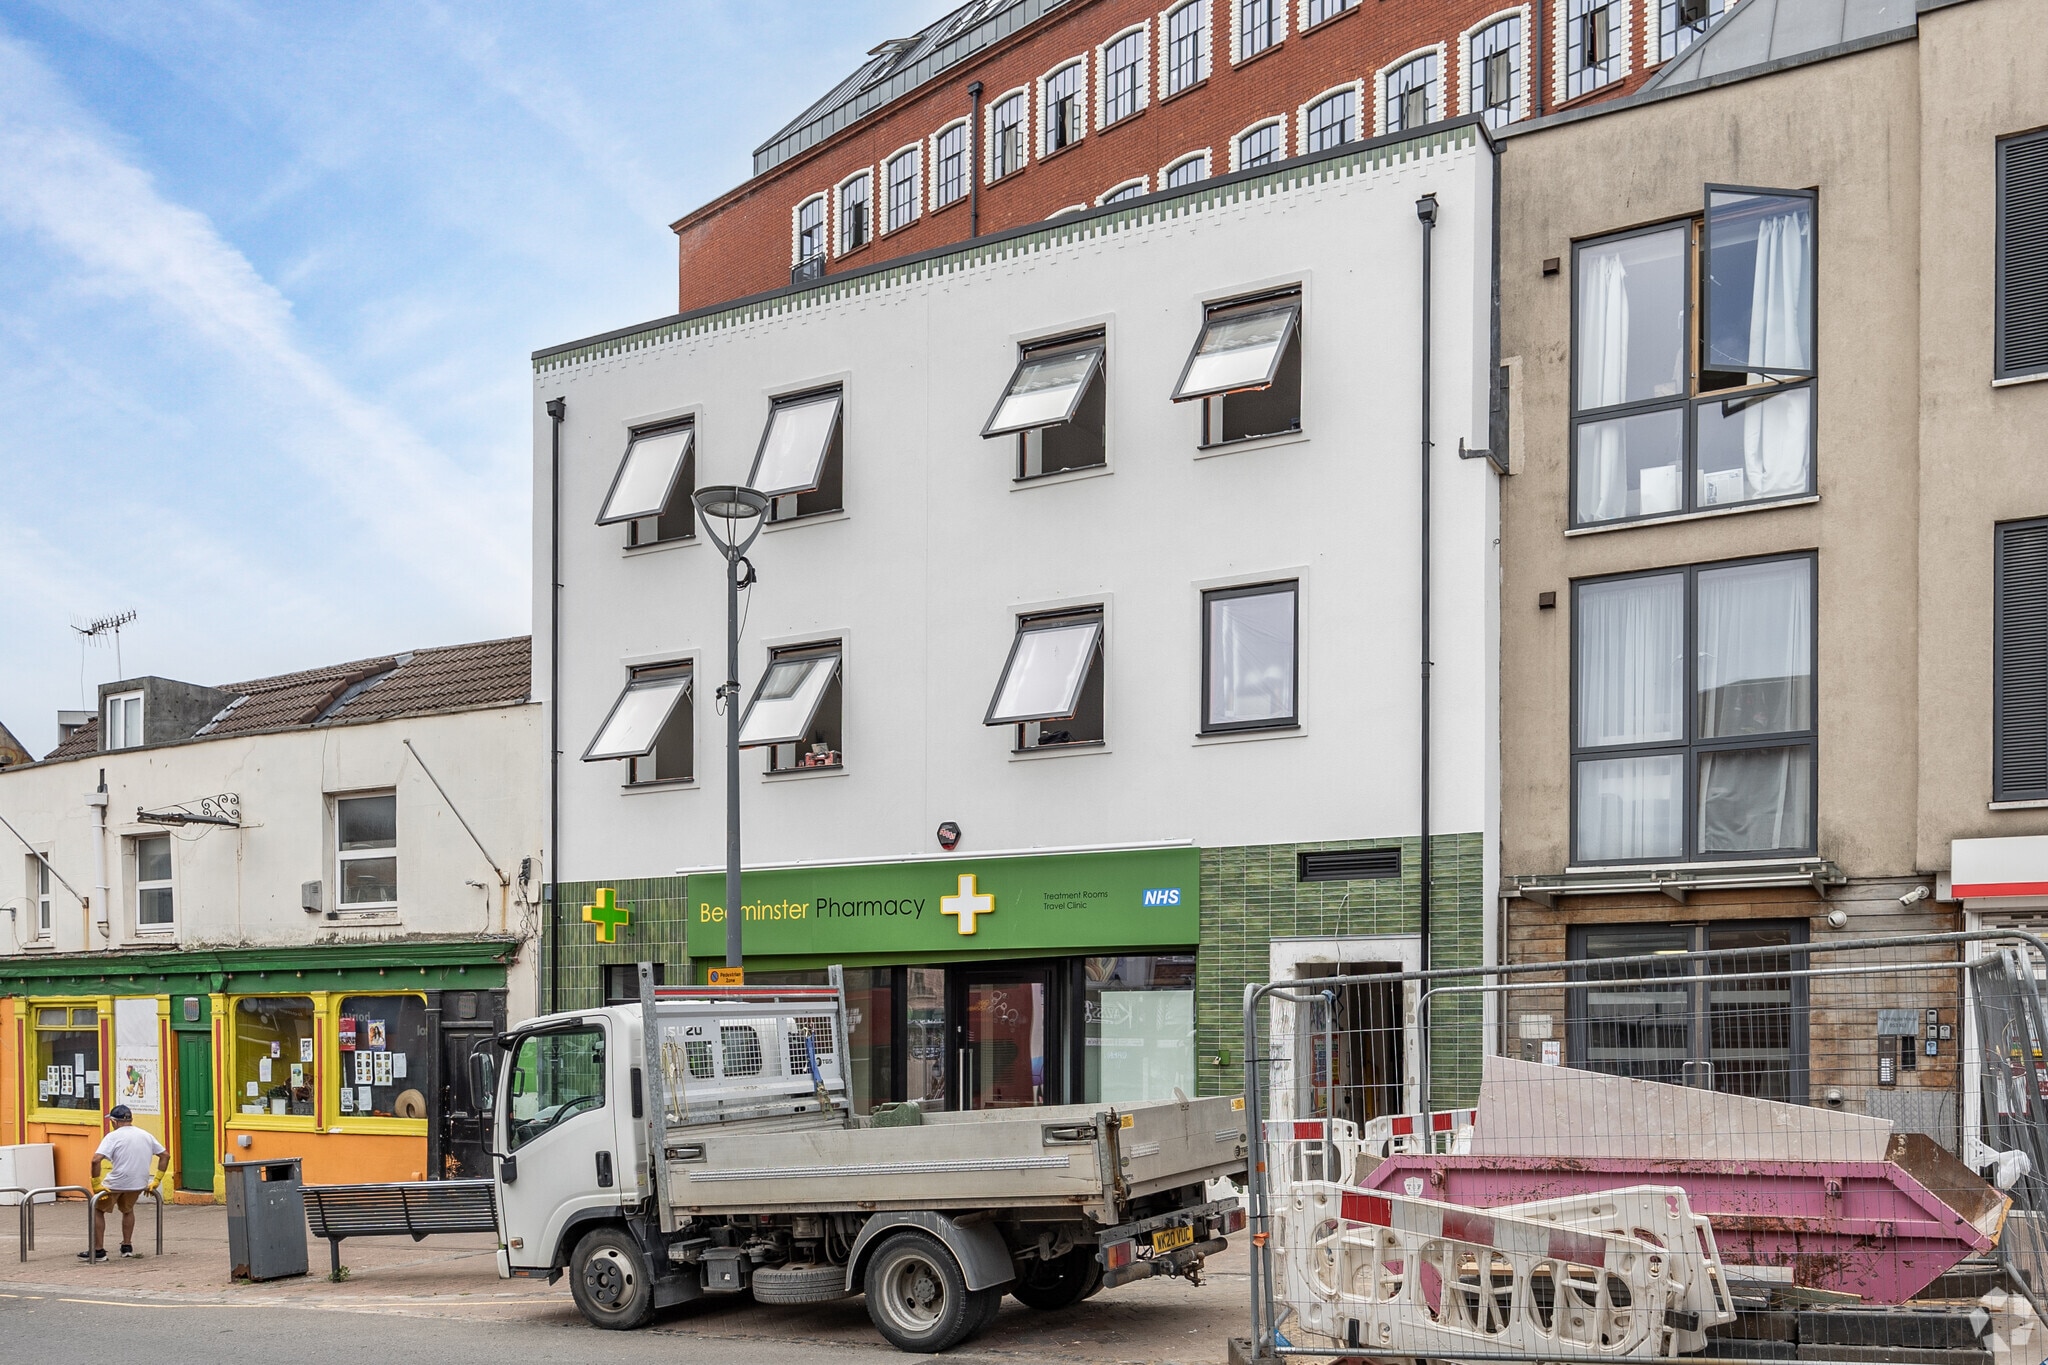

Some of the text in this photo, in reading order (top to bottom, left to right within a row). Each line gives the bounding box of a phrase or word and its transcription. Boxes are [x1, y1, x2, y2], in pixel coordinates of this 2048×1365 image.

[1043, 890, 1108, 900] Treatment Rooms
[1145, 889, 1179, 905] NHS
[700, 897, 926, 923] Beminster Pharmacy
[1043, 901, 1088, 910] Travel Clinic
[663, 1026, 702, 1036] ISUZU
[1156, 1227, 1191, 1250] WK20 VUC
